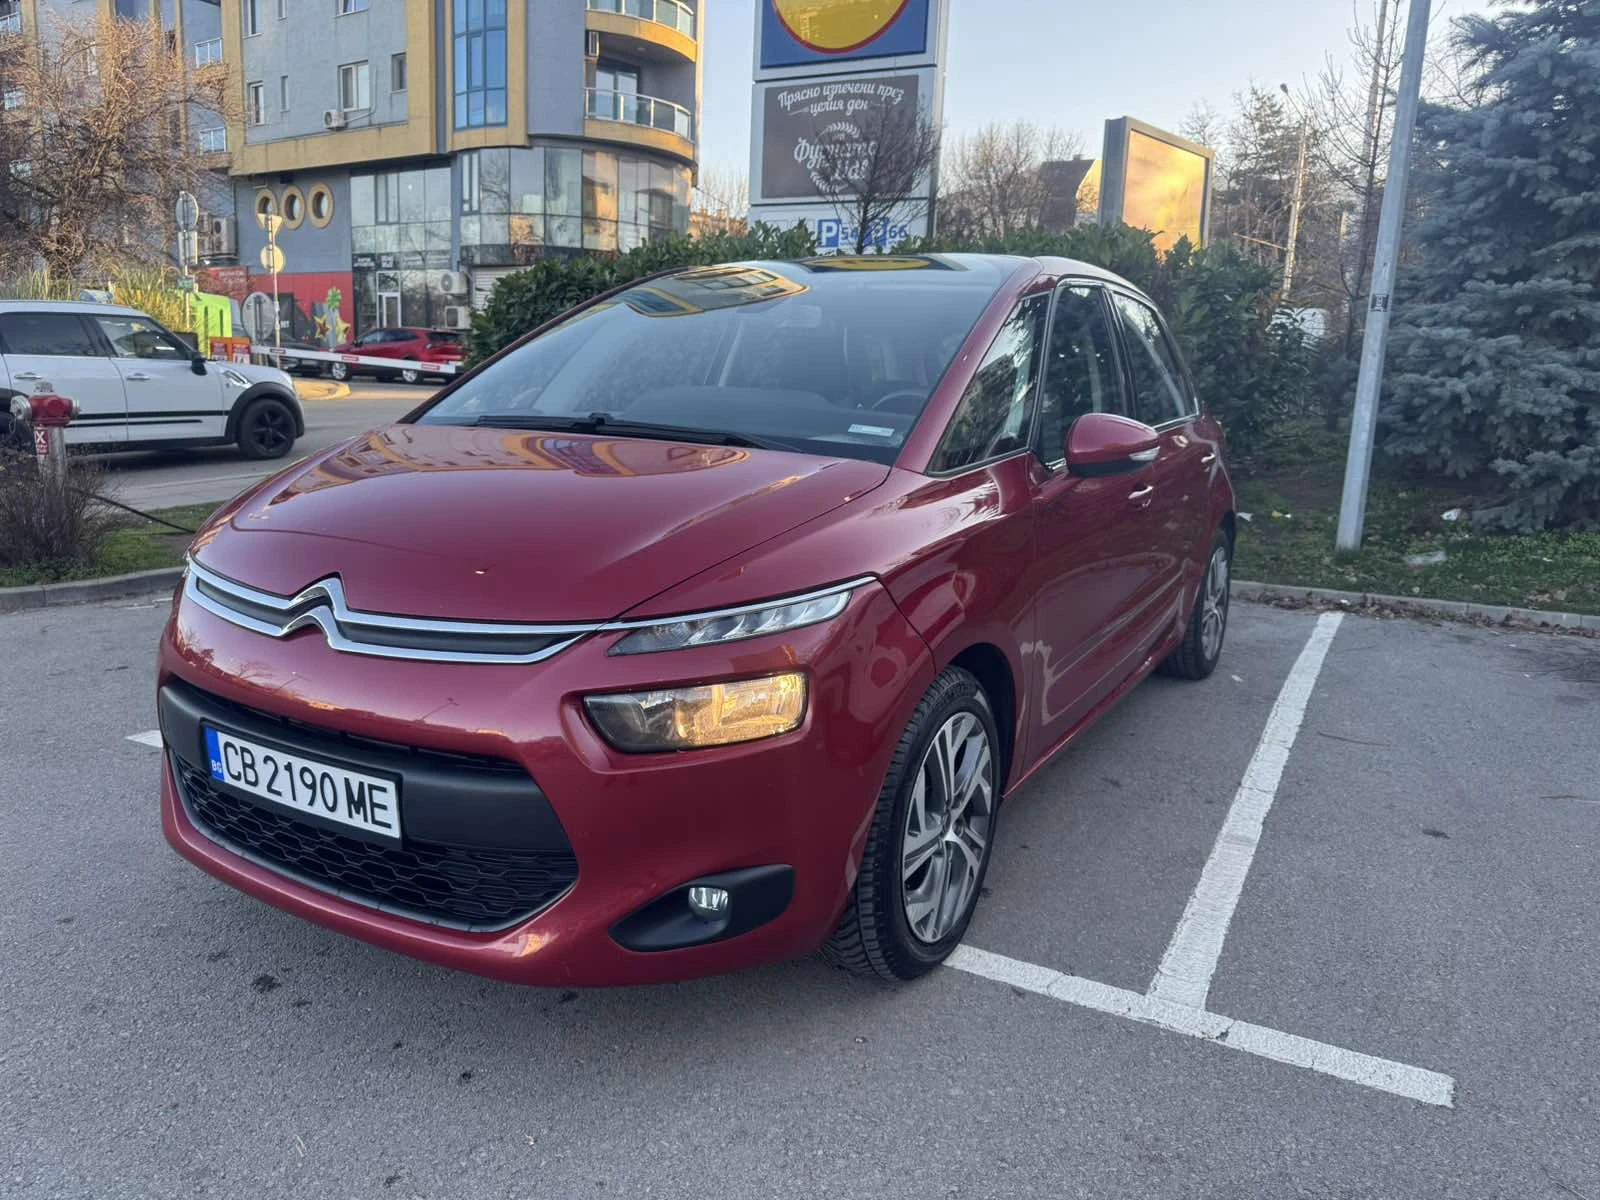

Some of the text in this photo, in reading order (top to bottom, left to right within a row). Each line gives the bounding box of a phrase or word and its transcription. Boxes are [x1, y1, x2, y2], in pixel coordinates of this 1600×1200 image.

[778, 83, 904, 111] Прясно изпечени през
[810, 99, 868, 116] целия ден
